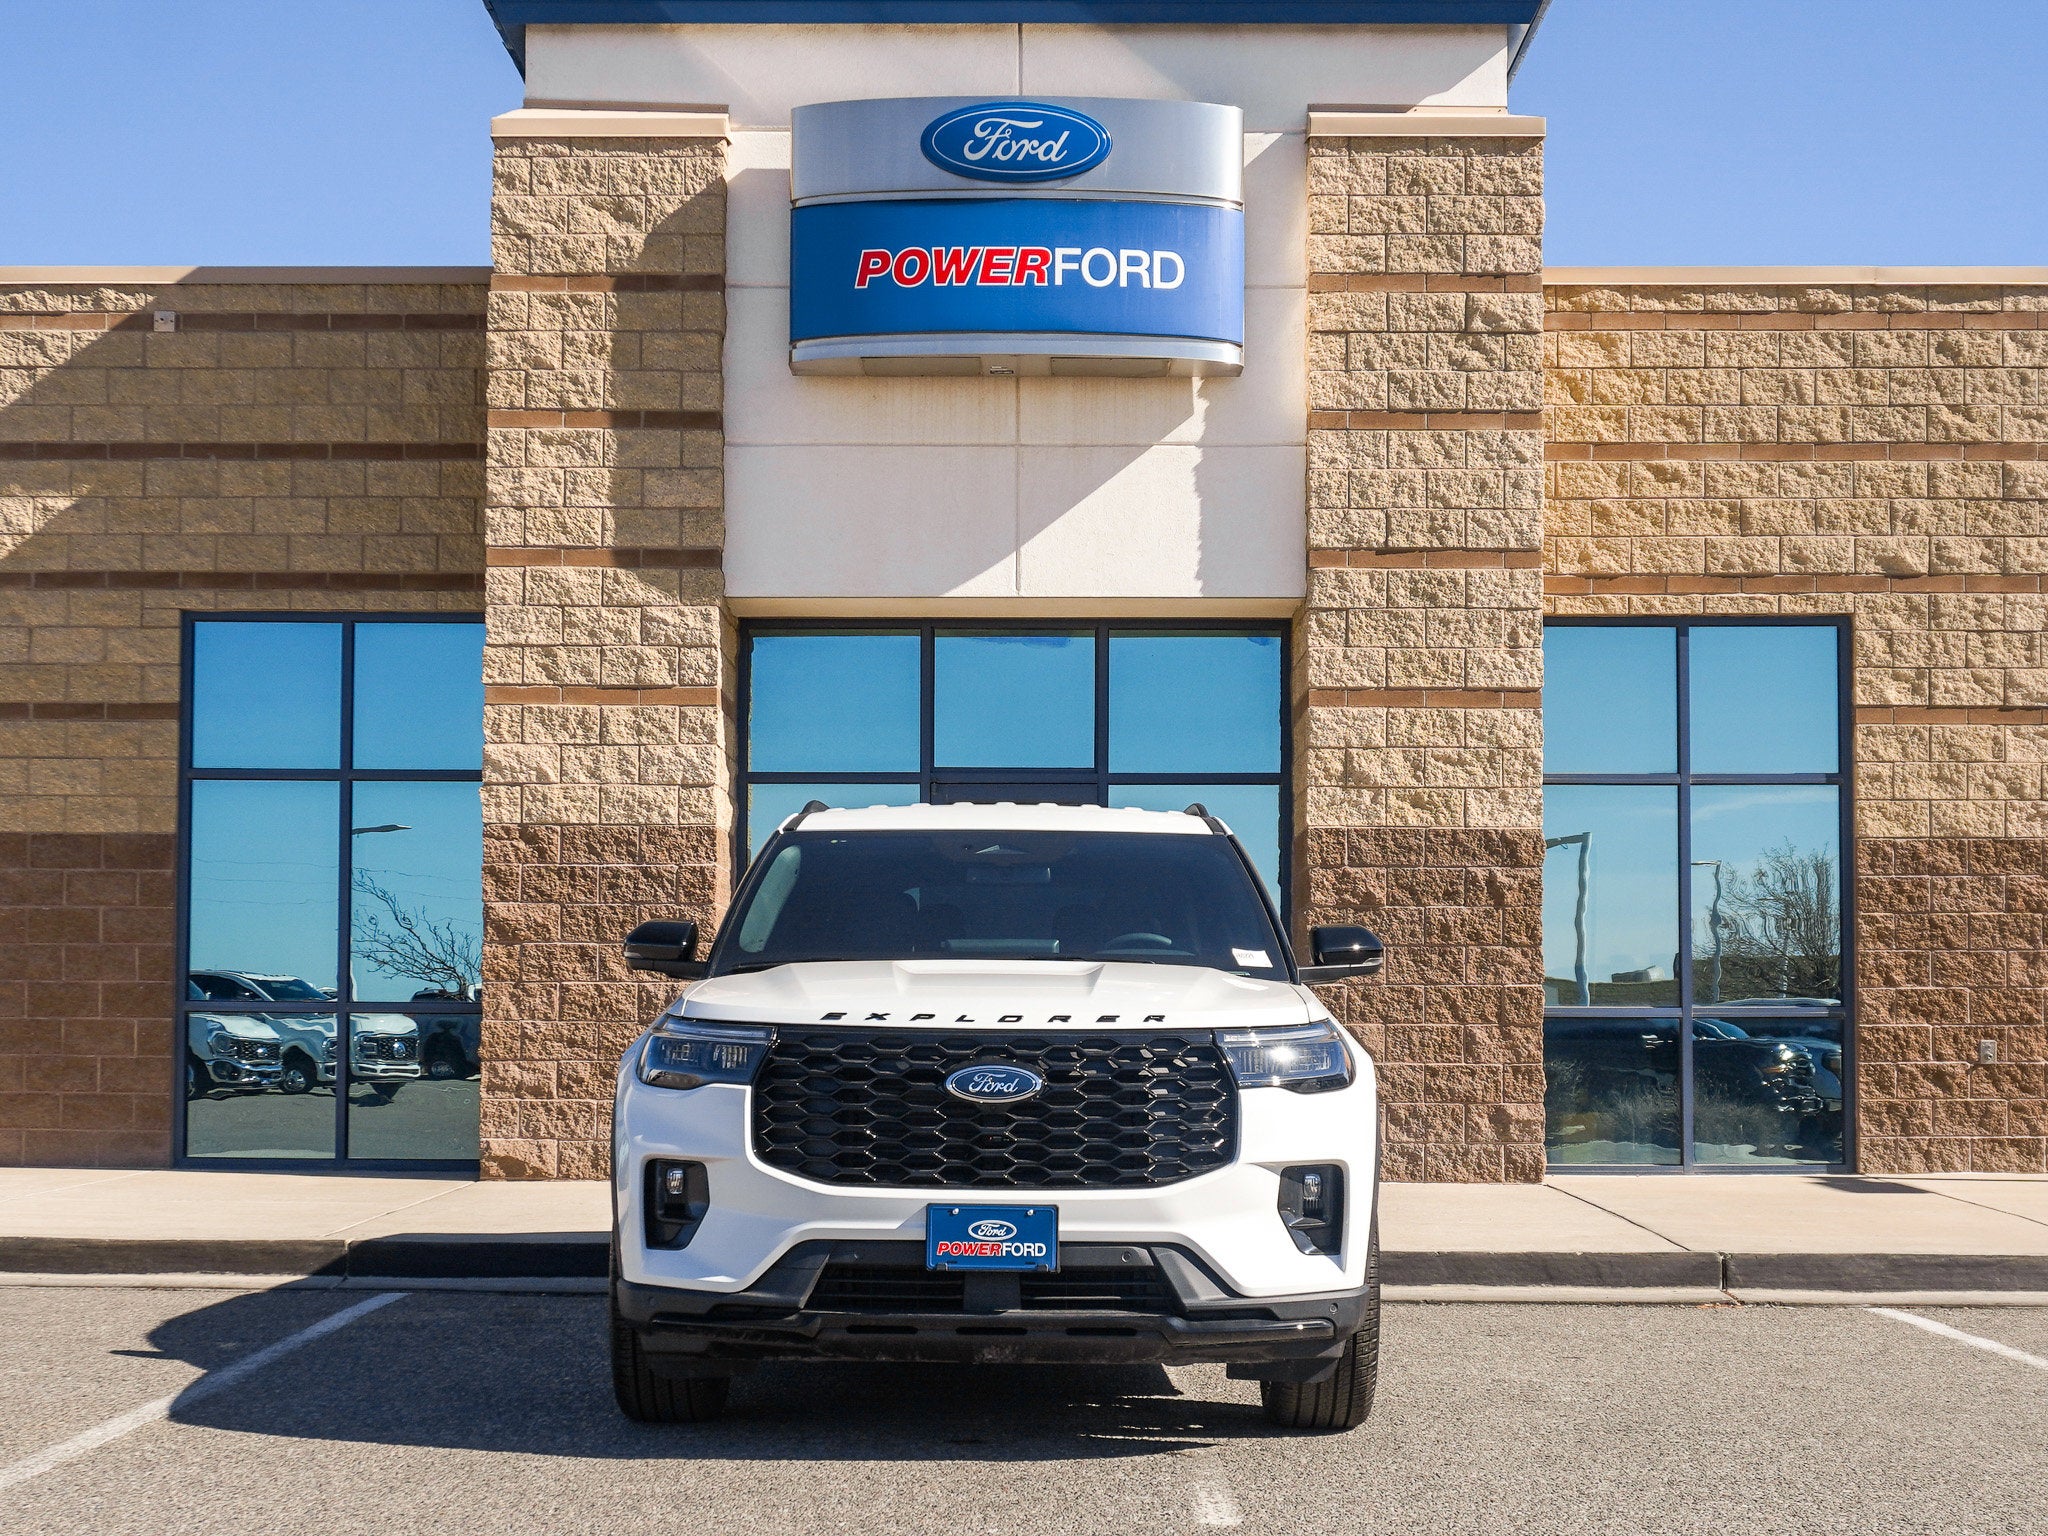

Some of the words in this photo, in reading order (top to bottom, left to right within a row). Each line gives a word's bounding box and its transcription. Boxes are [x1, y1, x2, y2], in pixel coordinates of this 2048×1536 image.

[964, 117, 1071, 163] Ford
[820, 1012, 1166, 1024] EXPLORER
[968, 1072, 1020, 1093] Ford
[977, 1223, 1007, 1237] Ford
